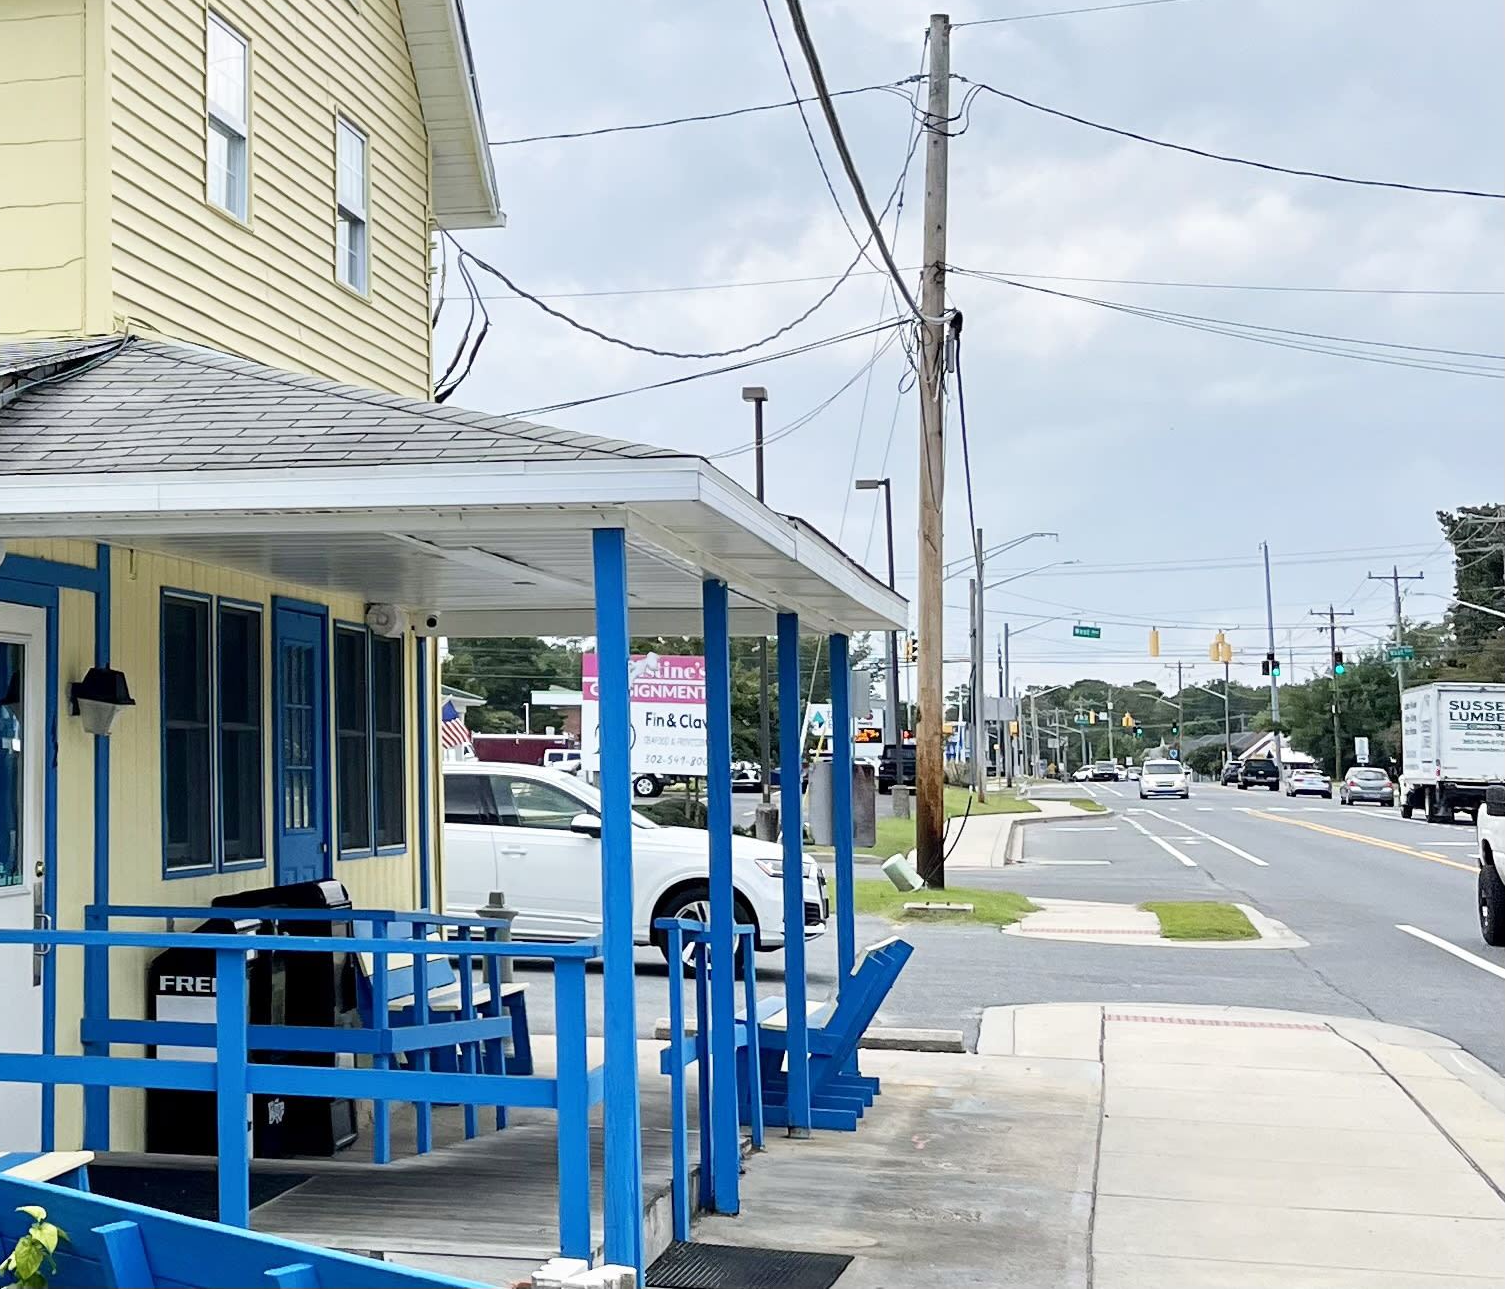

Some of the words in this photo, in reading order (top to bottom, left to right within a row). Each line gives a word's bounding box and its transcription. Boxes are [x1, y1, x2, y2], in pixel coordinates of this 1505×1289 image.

[1449, 700, 1505, 711] SUSSE
[645, 711, 665, 727] Fin
[666, 713, 677, 728] &
[1449, 711, 1505, 722] LUMBE
